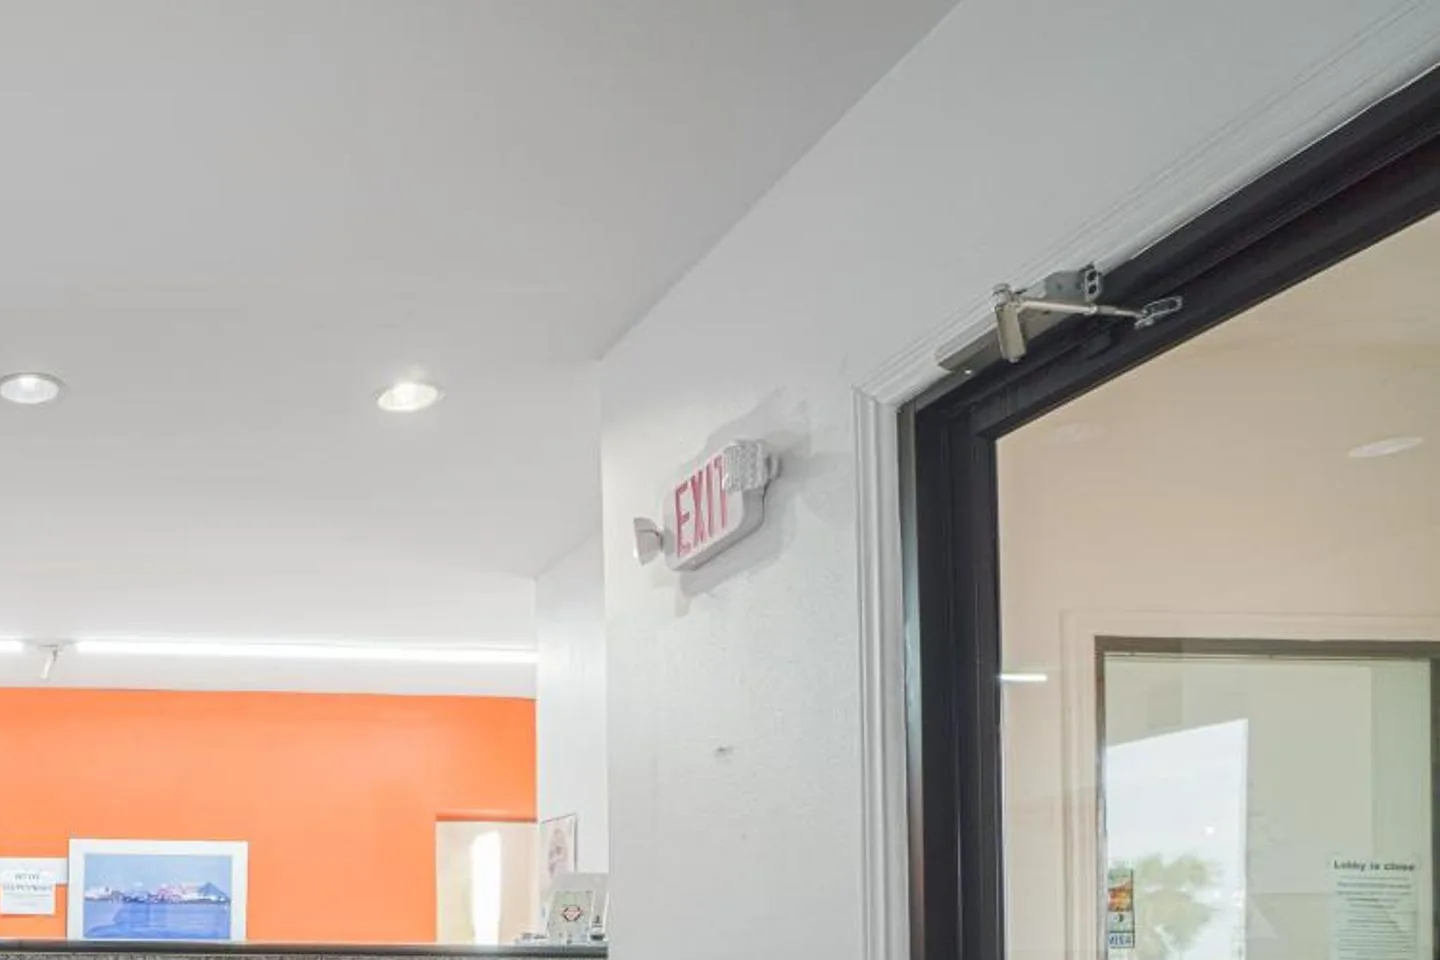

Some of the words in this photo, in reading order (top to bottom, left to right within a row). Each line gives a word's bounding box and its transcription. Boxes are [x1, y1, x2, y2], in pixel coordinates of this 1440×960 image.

[675, 455, 728, 558] EXIT
[1334, 860, 1366, 872] Lobby
[1370, 861, 1380, 870] is
